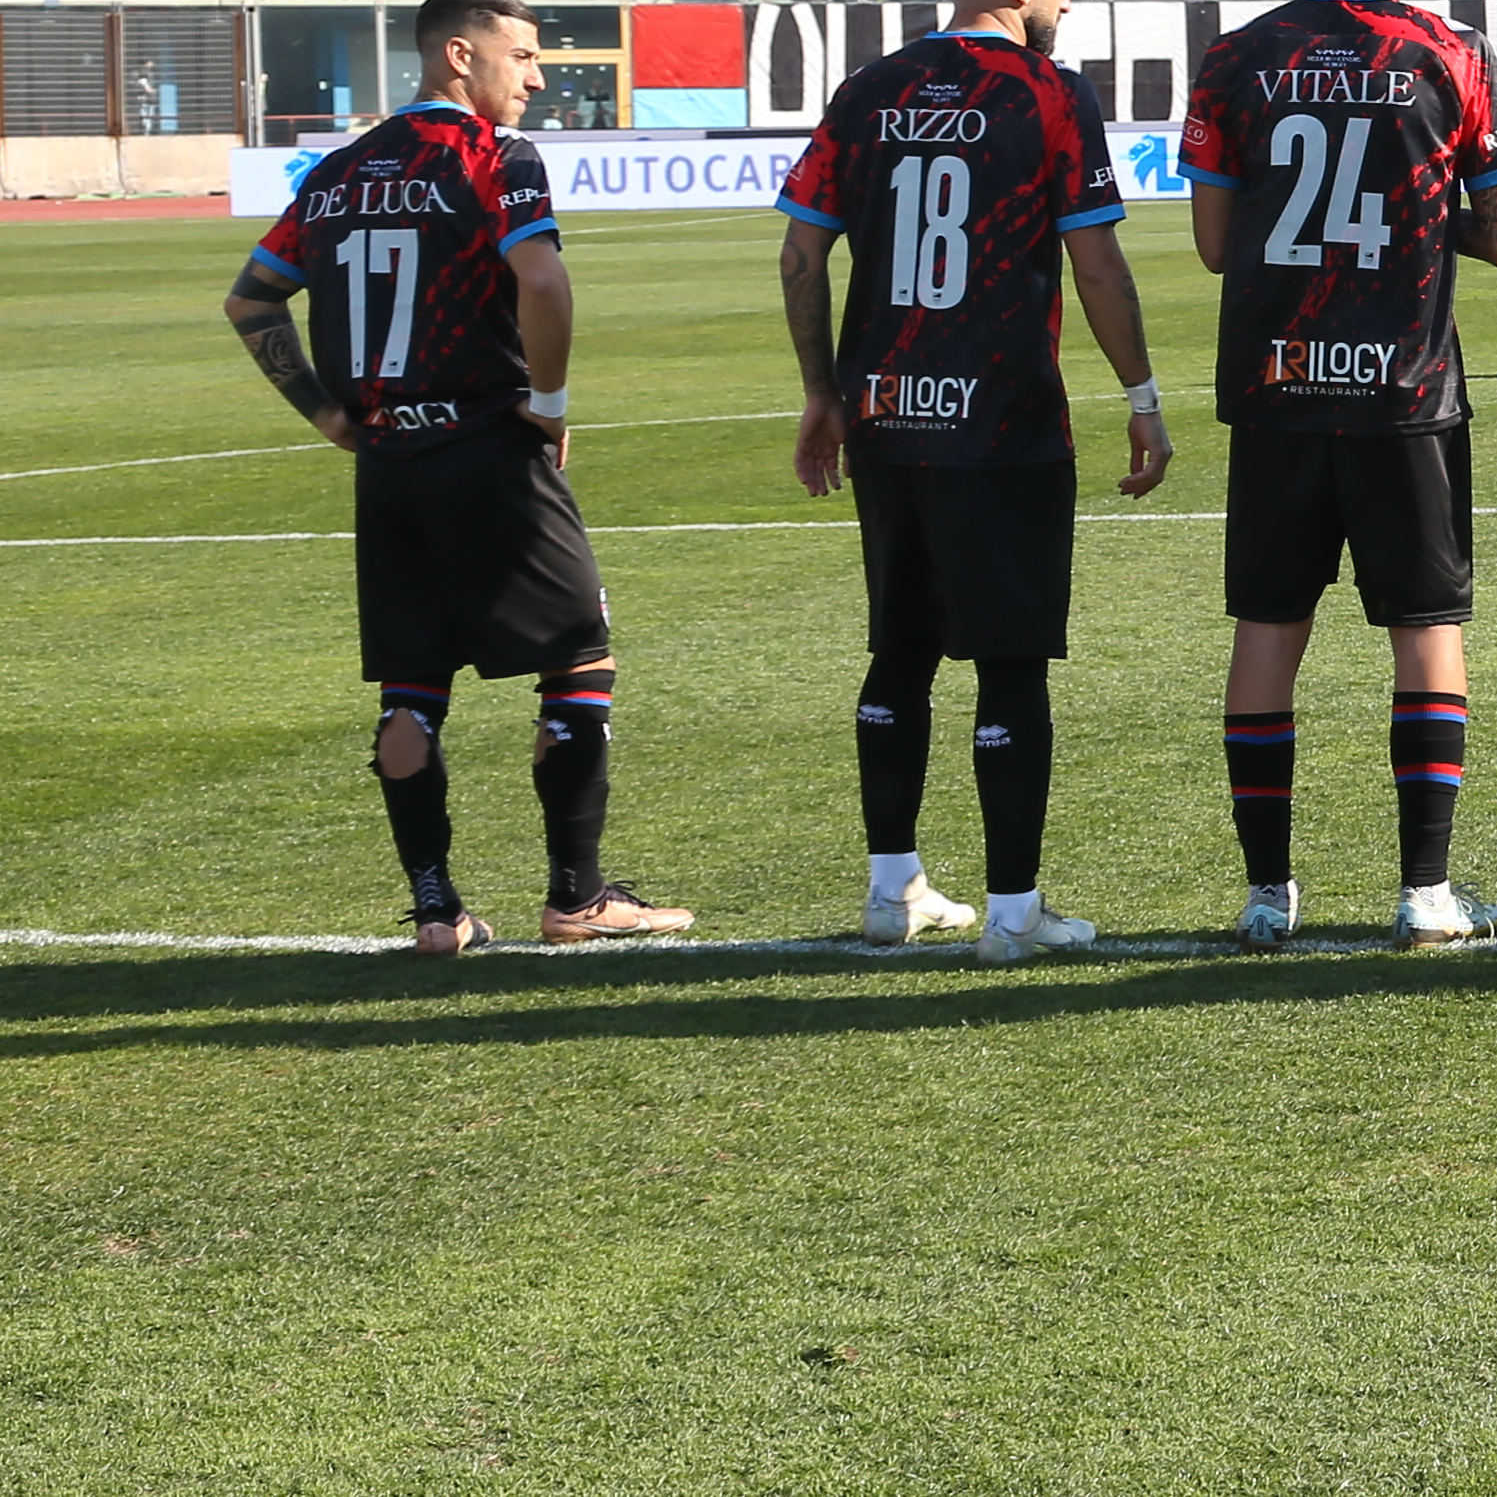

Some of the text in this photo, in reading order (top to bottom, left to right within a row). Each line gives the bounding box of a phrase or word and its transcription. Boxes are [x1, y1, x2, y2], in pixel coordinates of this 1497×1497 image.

[1256, 69, 1416, 107] VITALE
[878, 108, 987, 143] RIZZO
[304, 178, 457, 224] DE LUCA
[1264, 114, 1391, 269] 24
[890, 155, 970, 310] 18
[336, 229, 419, 380] 17
[1271, 339, 1397, 385] TRILOGY
[866, 374, 979, 419] TRILOGY
[1289, 385, 1368, 397] RESTAURANT
[880, 419, 949, 430] RESTAURANT
